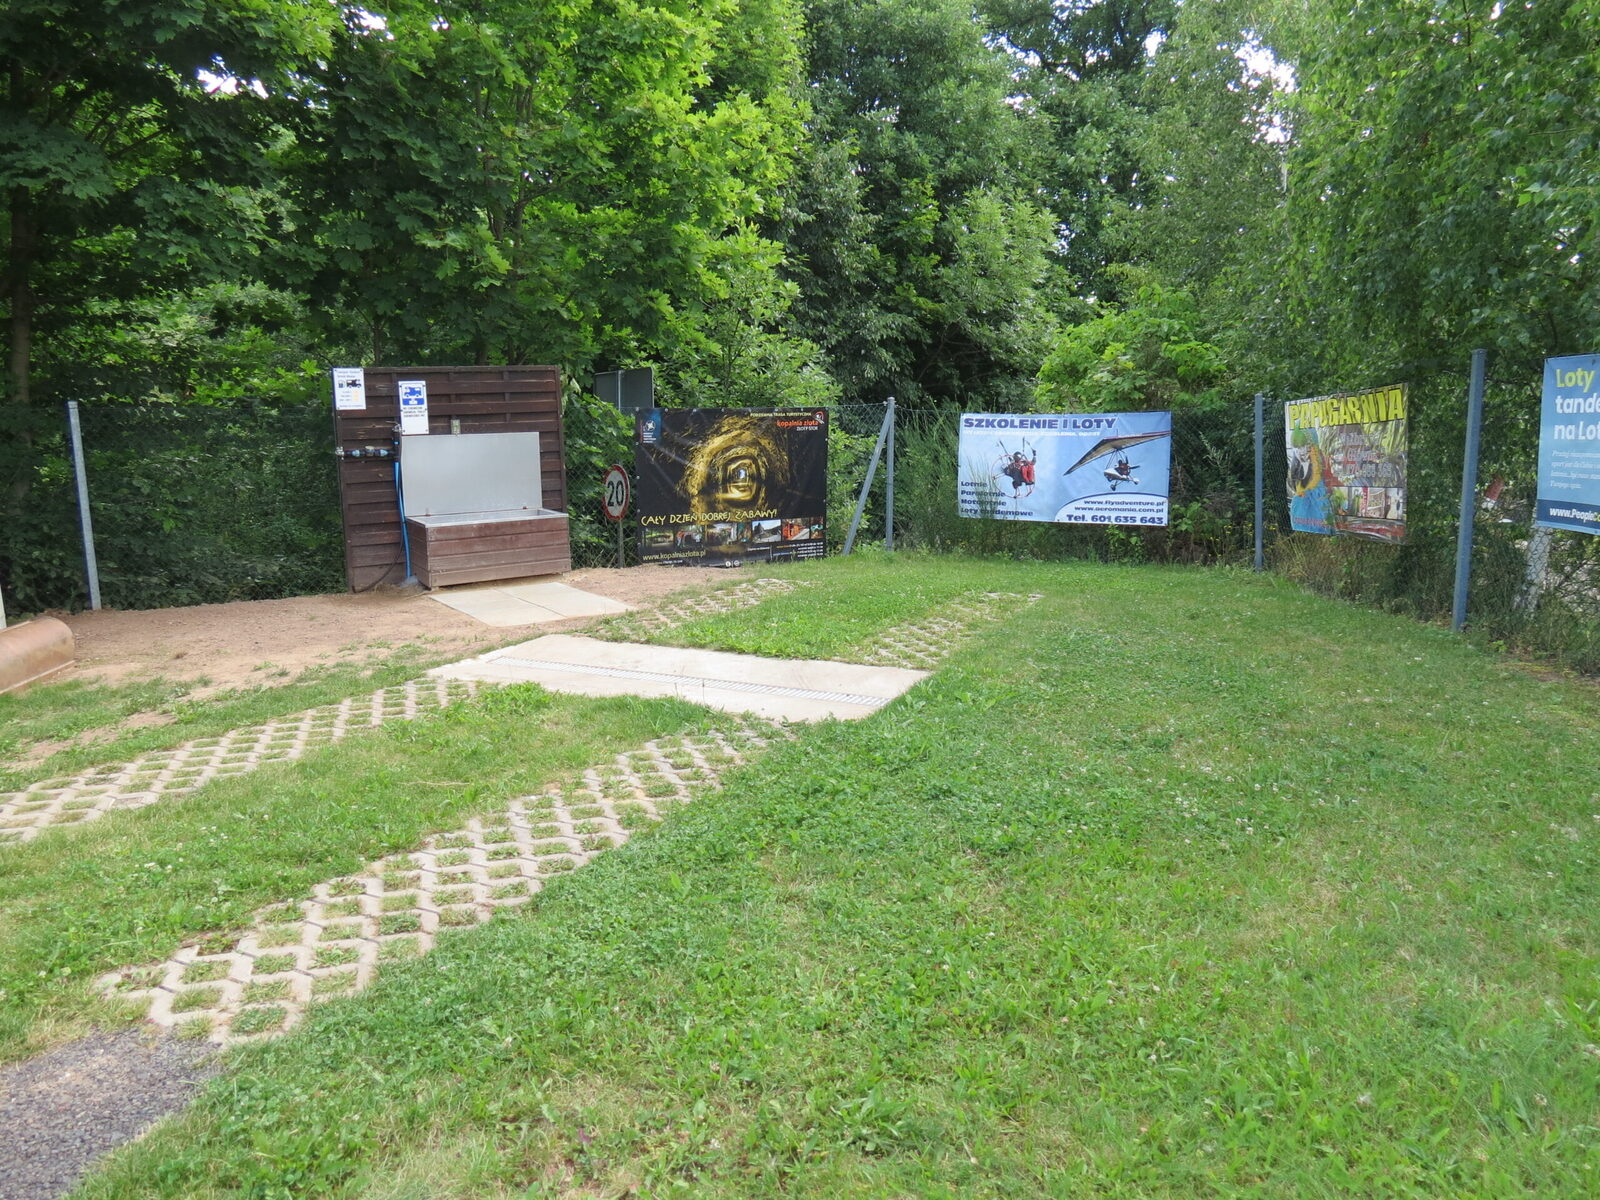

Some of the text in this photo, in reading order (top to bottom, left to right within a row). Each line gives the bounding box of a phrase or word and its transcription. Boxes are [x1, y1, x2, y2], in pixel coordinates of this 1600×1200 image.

[1556, 368, 1595, 393] Loty
[1289, 388, 1405, 429] PAPUGARNIA
[776, 419, 803, 428] kopalnia
[964, 417, 1117, 429] SZKOLENIE I LOTY
[1554, 424, 1575, 440] na
[607, 480, 624, 507] 20
[961, 489, 1006, 497] Paralotnie
[961, 498, 1007, 506] Motolotnie
[1084, 499, 1164, 507] www.flyadventure.pl
[640, 509, 778, 526] CAŁY DZIEŃ DOBREJ ZABAWY!
[961, 507, 1034, 517] Loty tandemowe
[1066, 514, 1164, 525] Tel. 601 635 643
[642, 549, 707, 560] www.kopalniazlota.pl
